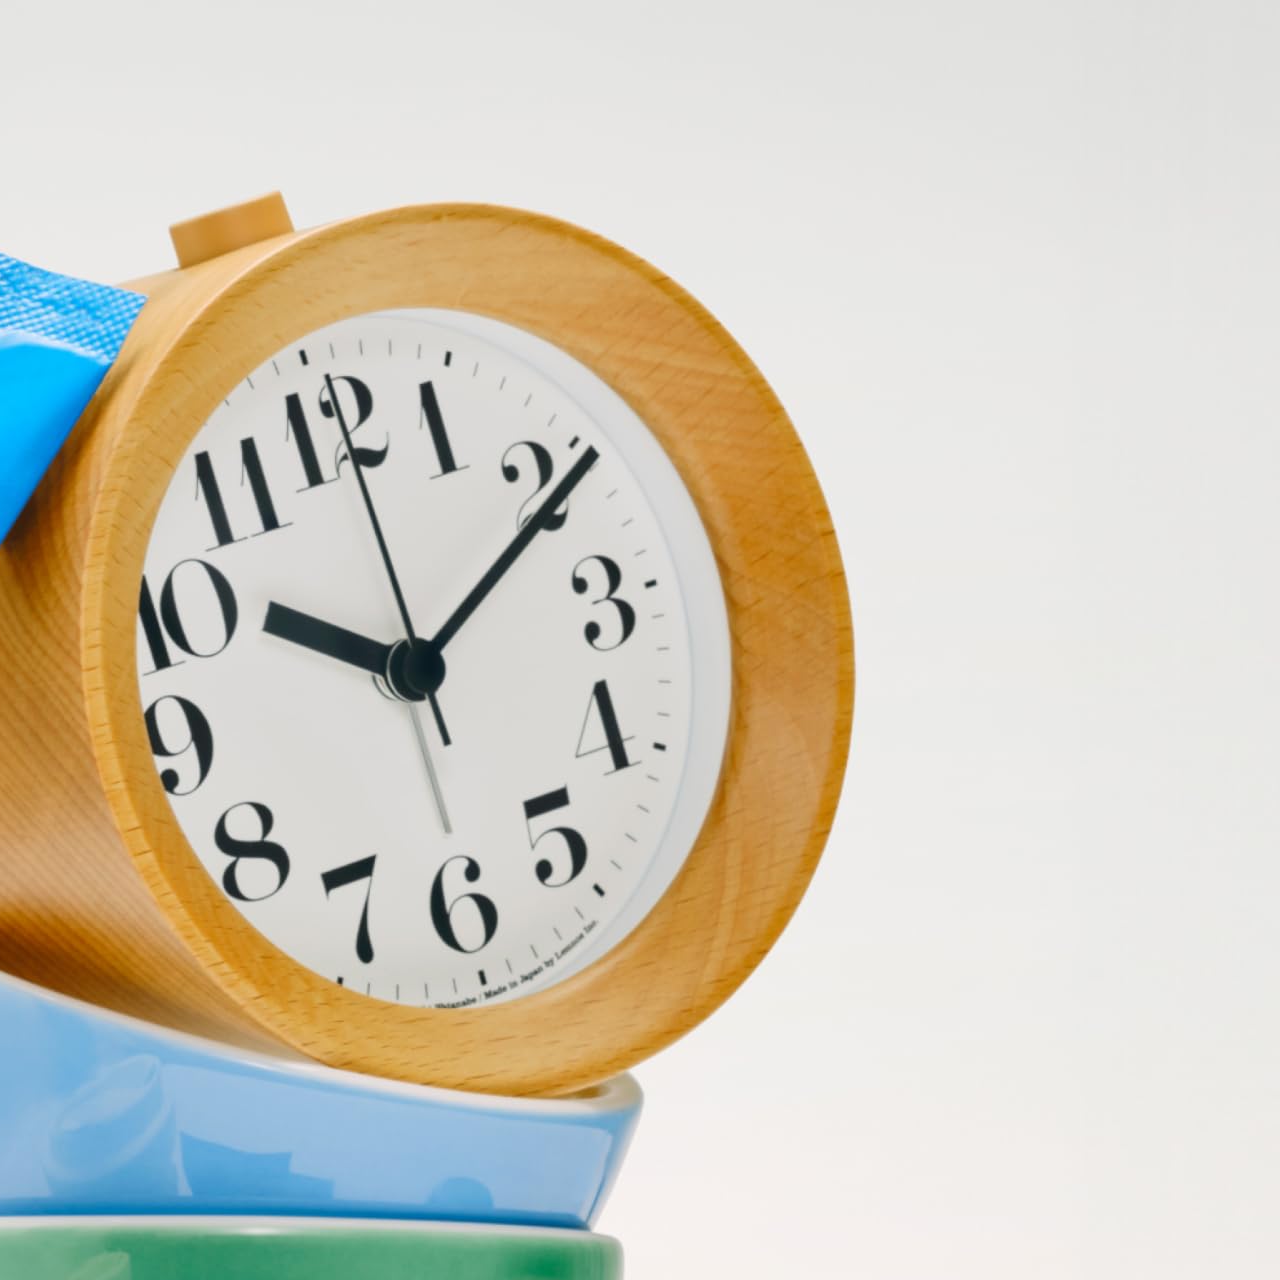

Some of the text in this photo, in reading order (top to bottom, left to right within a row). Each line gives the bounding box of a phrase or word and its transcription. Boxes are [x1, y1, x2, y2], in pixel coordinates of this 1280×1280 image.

[284, 375, 390, 493] 12
[419, 380, 470, 480] 1
[194, 436, 293, 551] 11
[500, 440, 569, 532] 2
[137, 558, 238, 676] 10
[571, 555, 636, 651] 3
[144, 695, 215, 796] 9
[574, 679, 642, 776] 4
[214, 801, 290, 902] 8
[523, 785, 587, 887] 5
[320, 854, 377, 964] 7
[429, 855, 499, 954] 6
[520, 965, 544, 985] Japan
